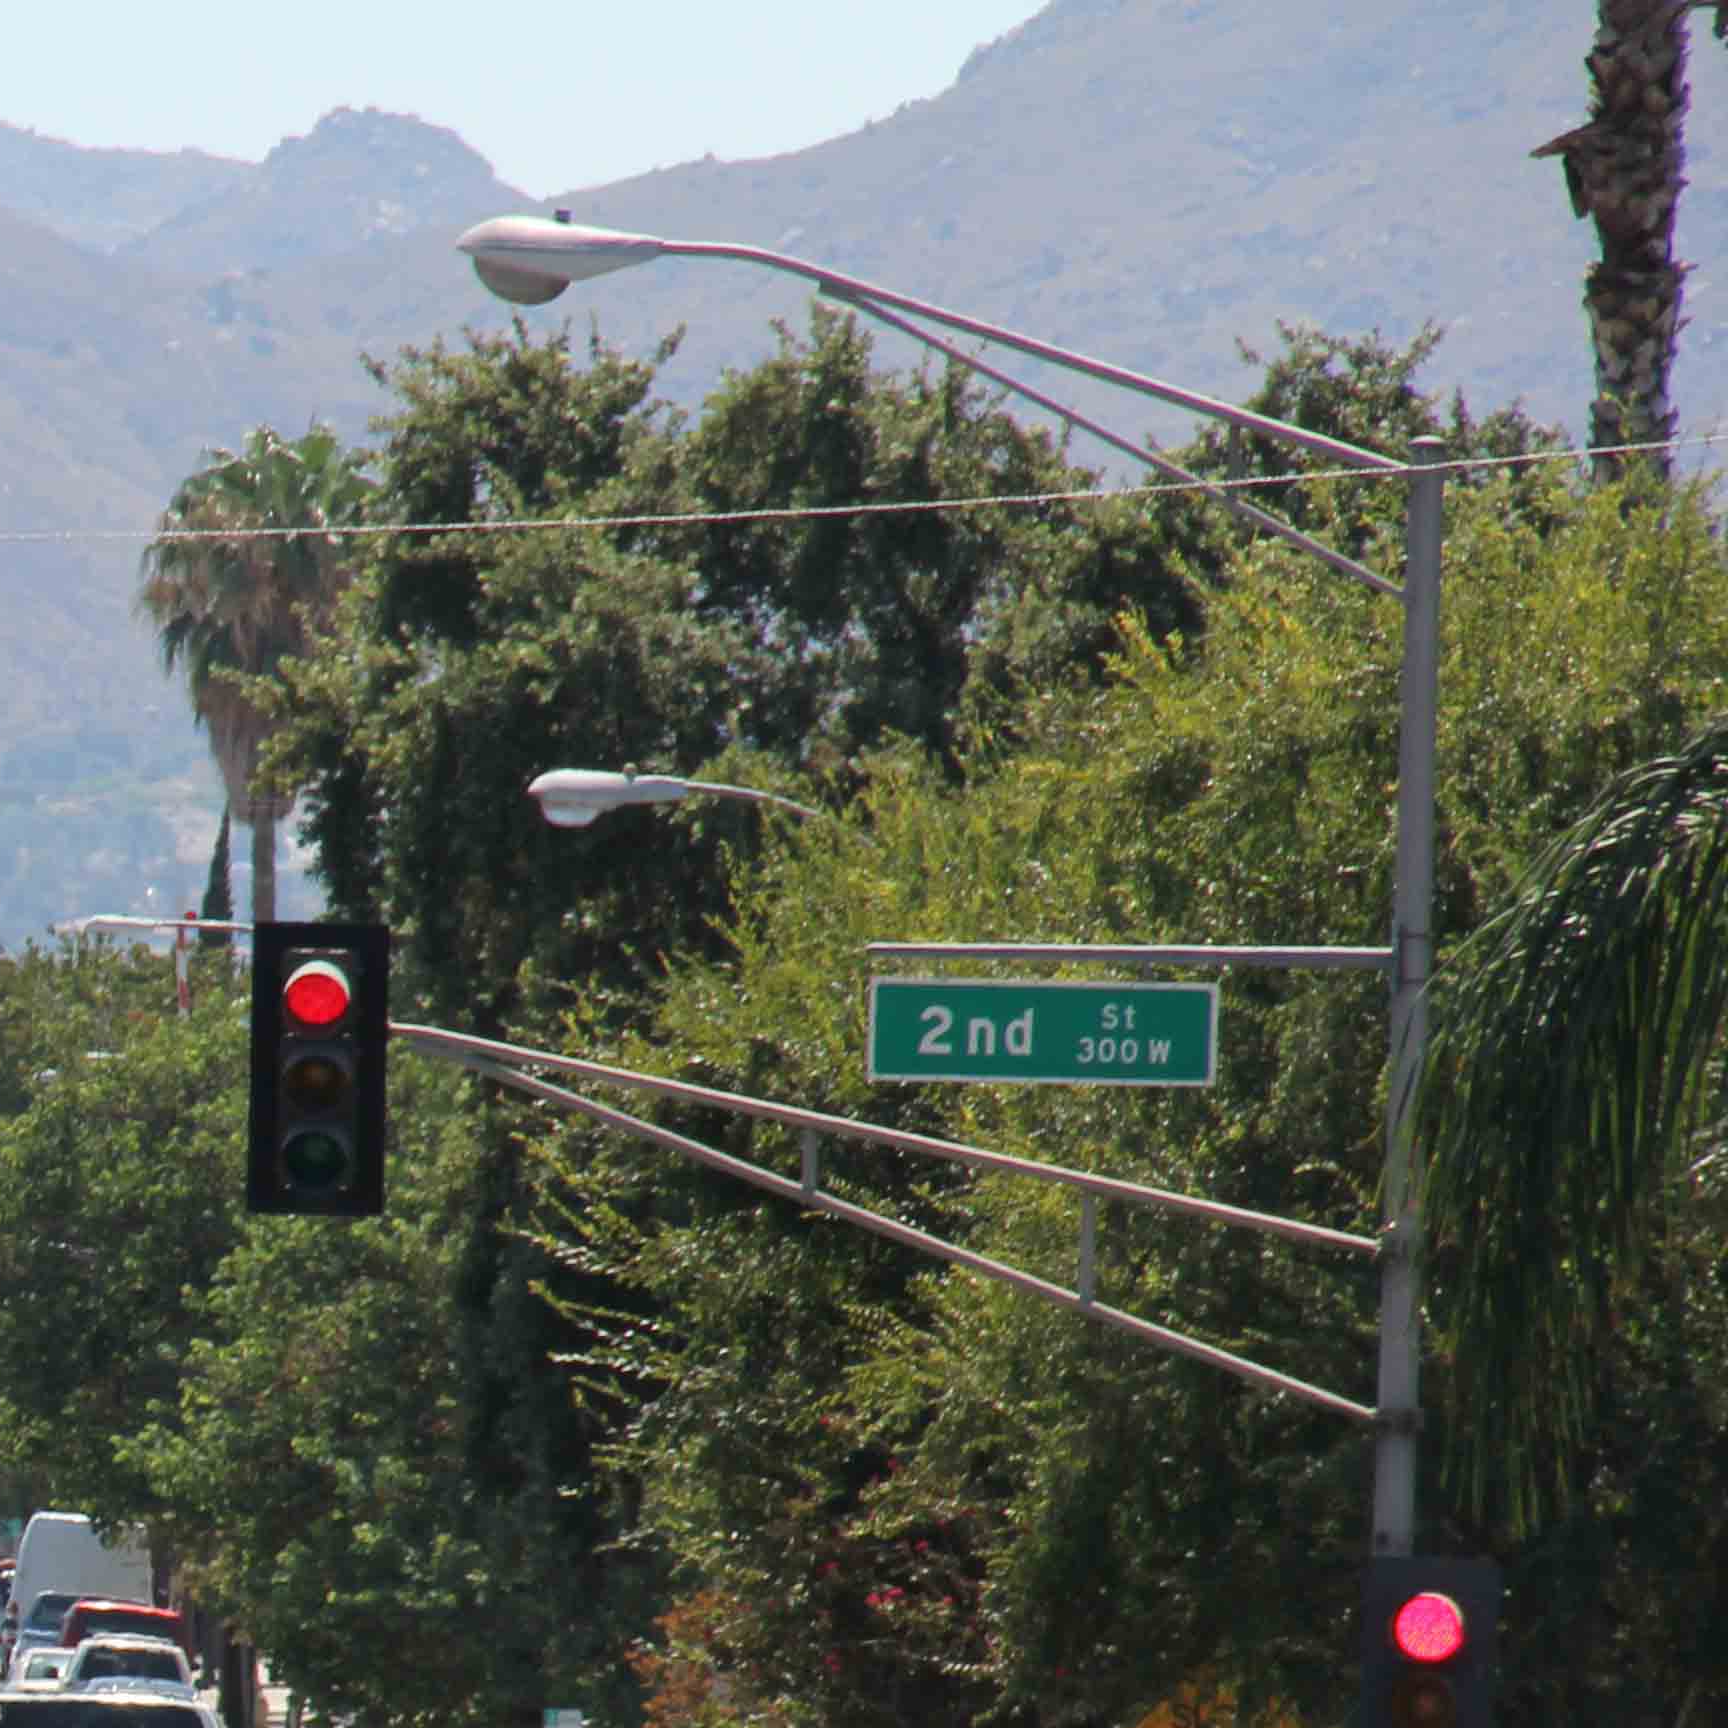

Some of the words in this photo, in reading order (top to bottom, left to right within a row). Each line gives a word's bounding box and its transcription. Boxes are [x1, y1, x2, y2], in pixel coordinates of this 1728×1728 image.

[917, 1004, 1034, 1056] 2nd
[1101, 1003, 1136, 1030] St
[1076, 1038, 1138, 1064] 300
[1148, 1039, 1172, 1064] W
